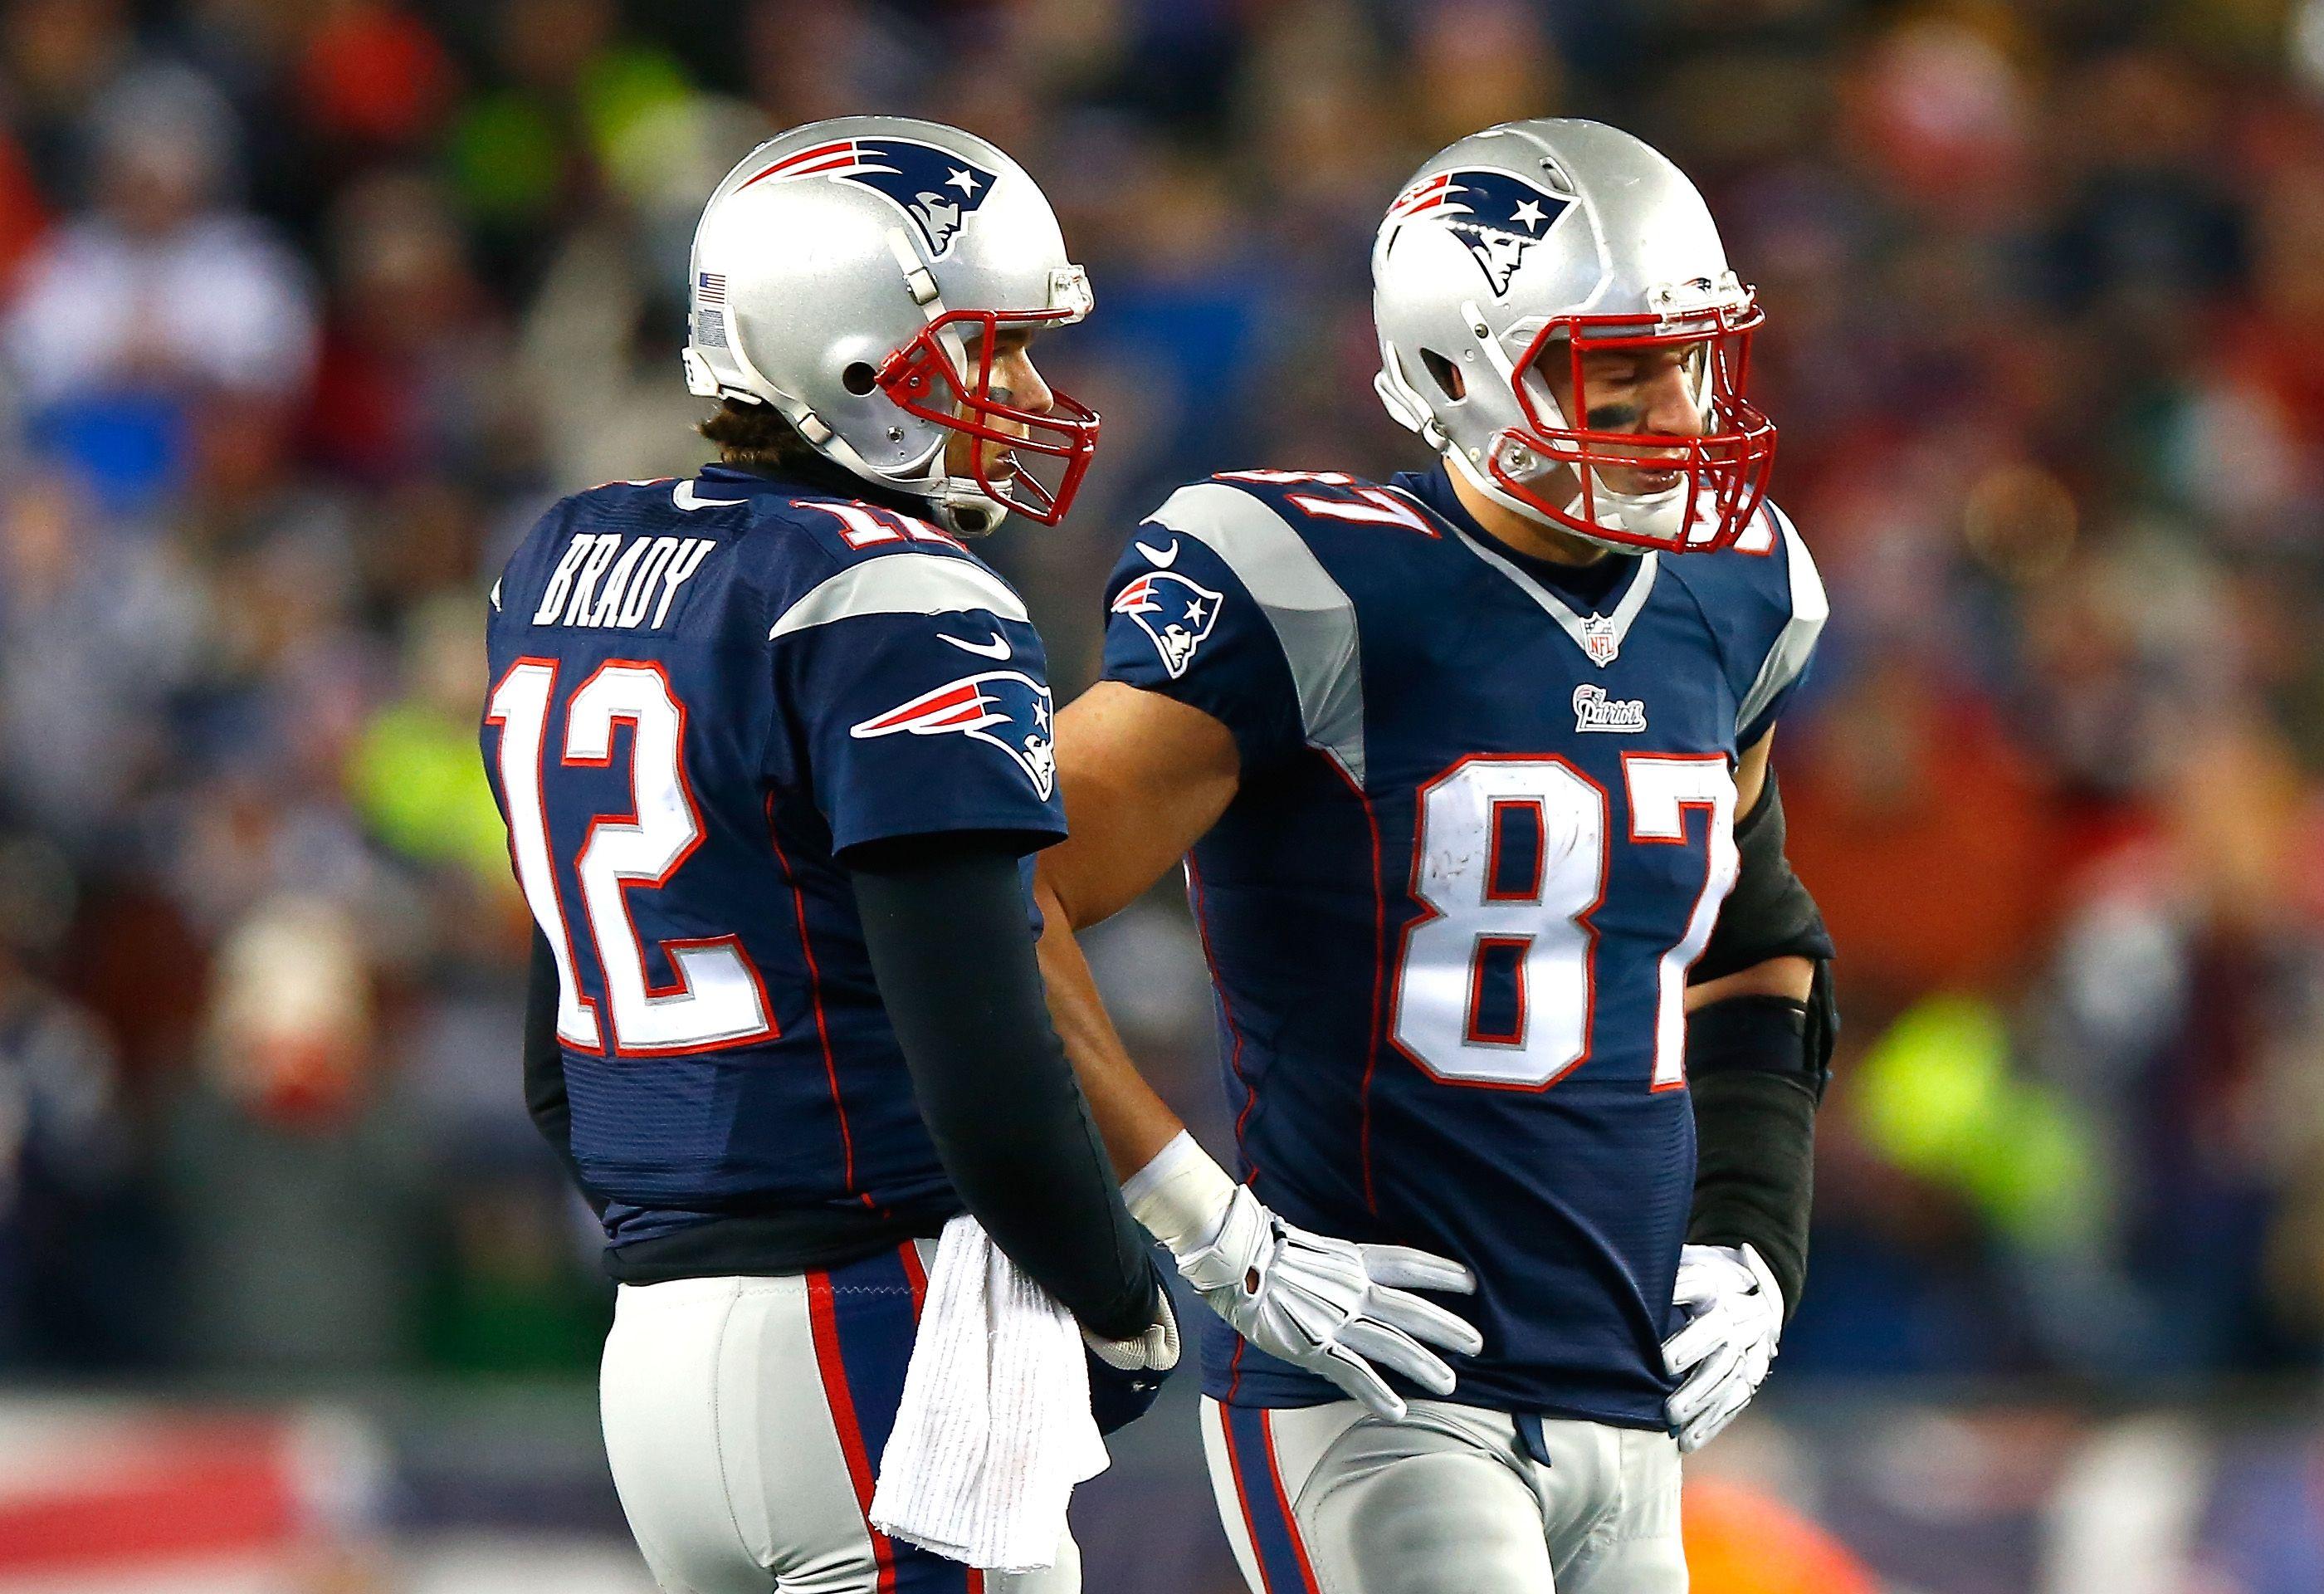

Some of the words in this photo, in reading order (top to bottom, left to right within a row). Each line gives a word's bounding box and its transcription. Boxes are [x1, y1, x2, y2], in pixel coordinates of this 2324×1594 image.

[531, 531, 718, 630] BRADY
[1589, 635, 1615, 657] NFL
[1575, 698, 1646, 730] Patriots
[485, 655, 782, 1059] 12
[1386, 751, 1741, 1094] 87
